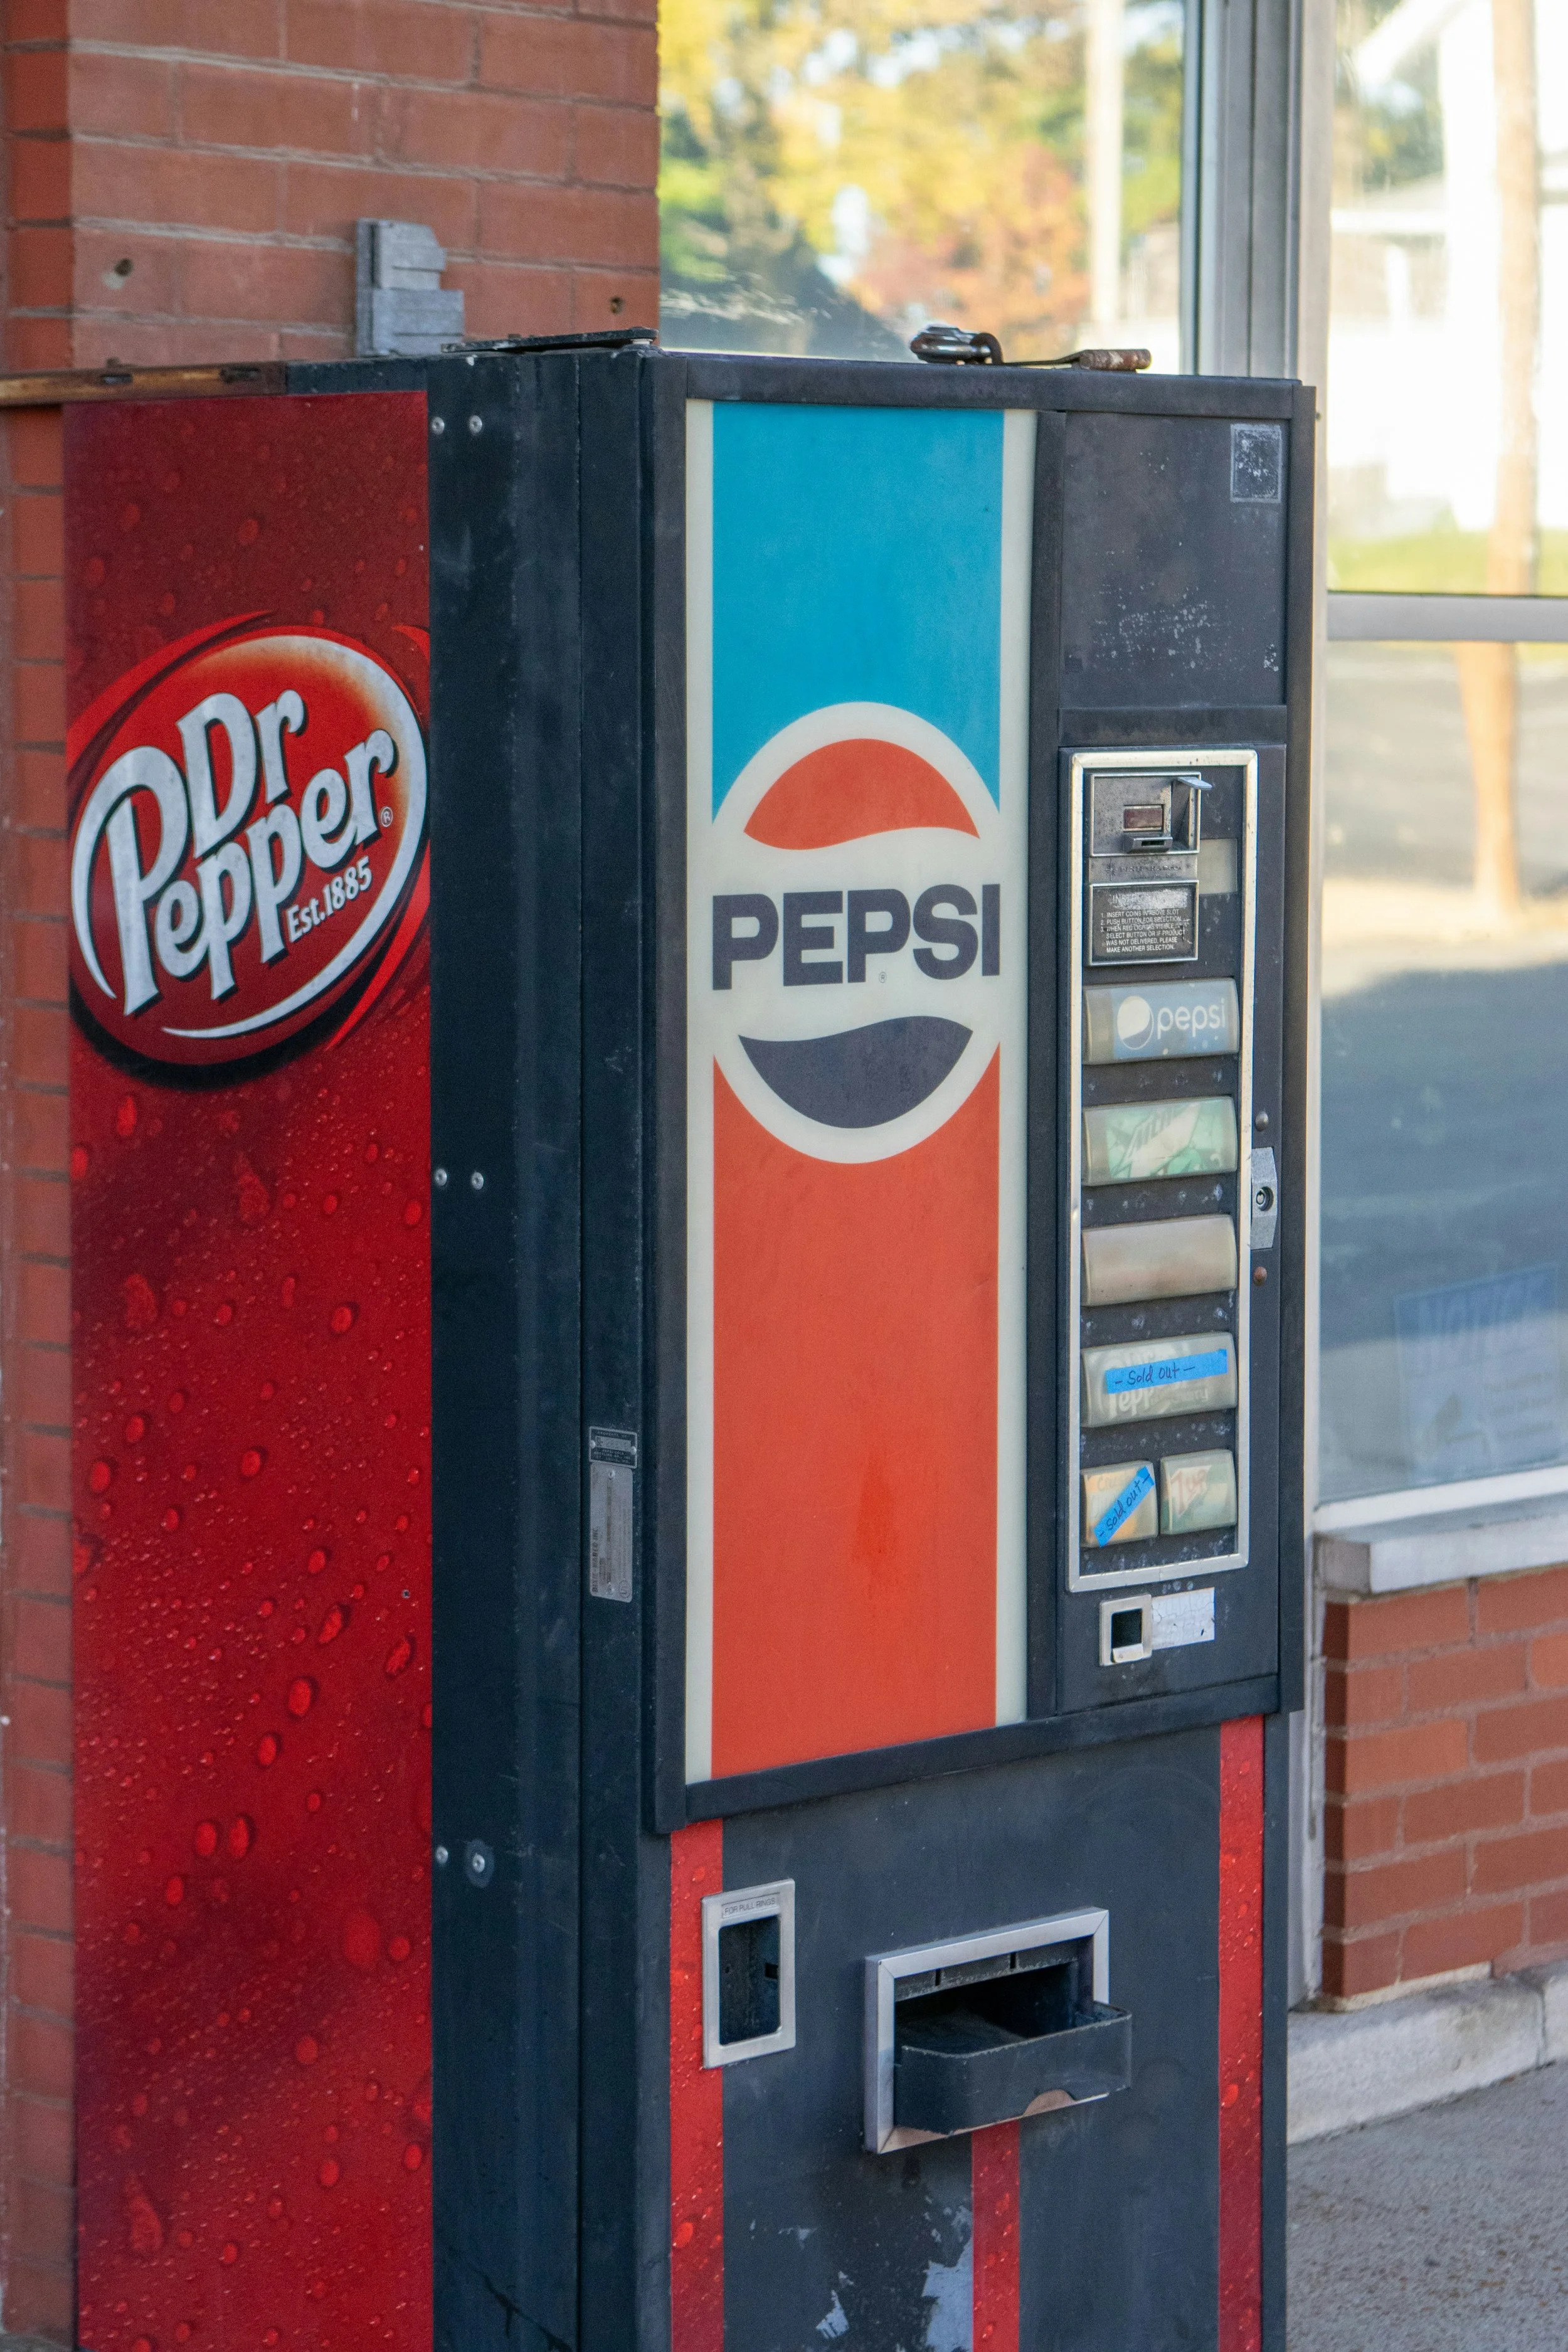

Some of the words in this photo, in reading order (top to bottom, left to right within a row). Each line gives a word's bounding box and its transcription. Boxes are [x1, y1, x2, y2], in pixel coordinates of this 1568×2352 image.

[176, 690, 306, 858] Dr
[72, 729, 395, 1015] Pepper
[712, 884, 1000, 990] PEPSI
[1157, 997, 1226, 1040] pepsi
[1128, 1365, 1154, 1386] Sold
[1158, 1361, 1180, 1380] out
[1106, 1500, 1127, 1530] Sold
[1126, 1480, 1142, 1507] out
[724, 1905, 738, 1915] FOR
[739, 1903, 755, 1911] PULL
[756, 1897, 775, 1907] RINGS
